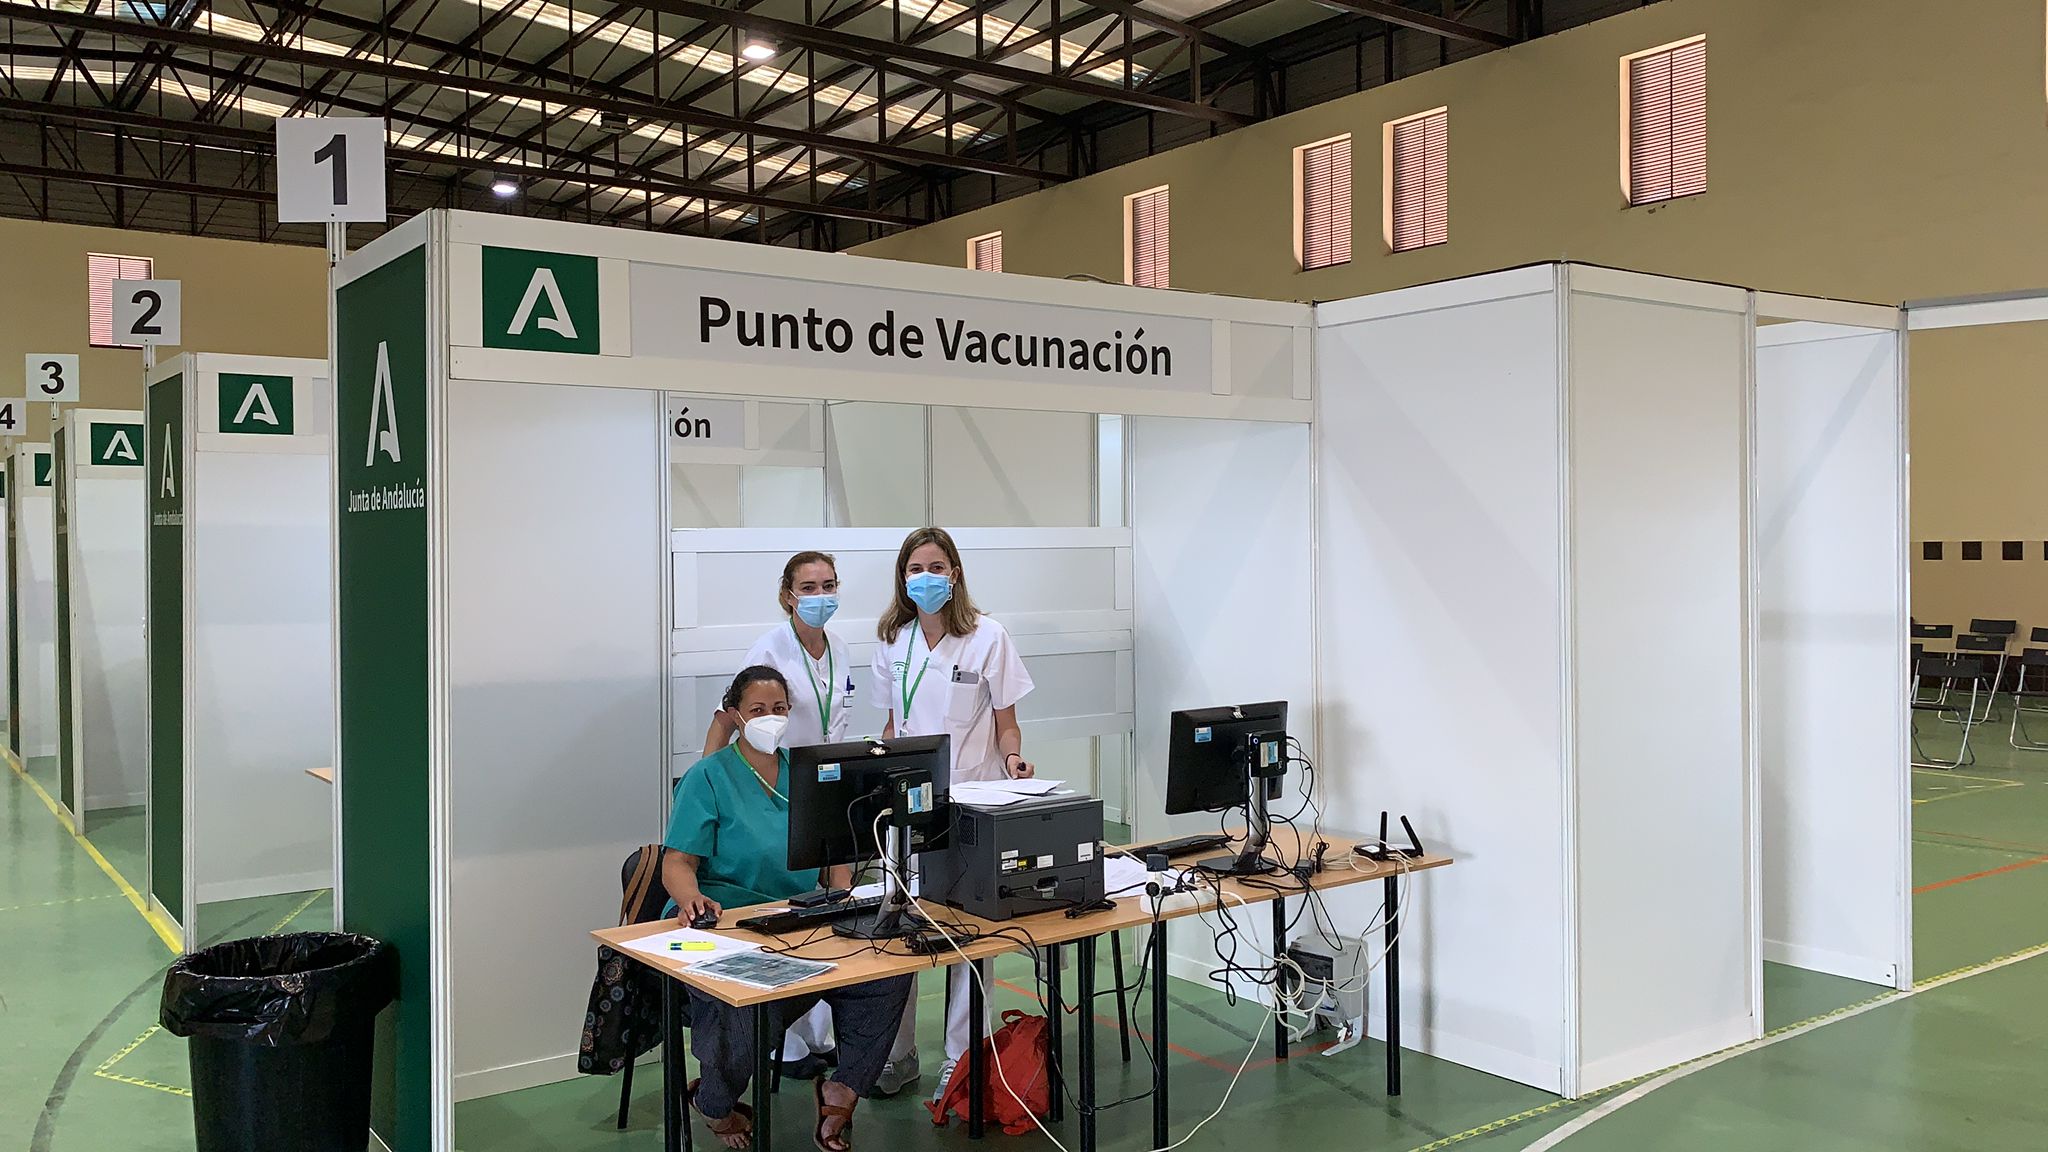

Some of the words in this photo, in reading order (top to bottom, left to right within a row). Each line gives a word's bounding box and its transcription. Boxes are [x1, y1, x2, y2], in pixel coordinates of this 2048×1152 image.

[314, 134, 348, 205] 1
[130, 290, 162, 335] 2
[700, 296, 853, 354] Punto
[868, 310, 924, 359] de
[935, 317, 1172, 376] Vacunación
[40, 361, 65, 395] 3
[0, 403, 16, 430] 4
[348, 489, 370, 513] Junta
[371, 485, 381, 511] de
[382, 477, 425, 511] Andalucía
